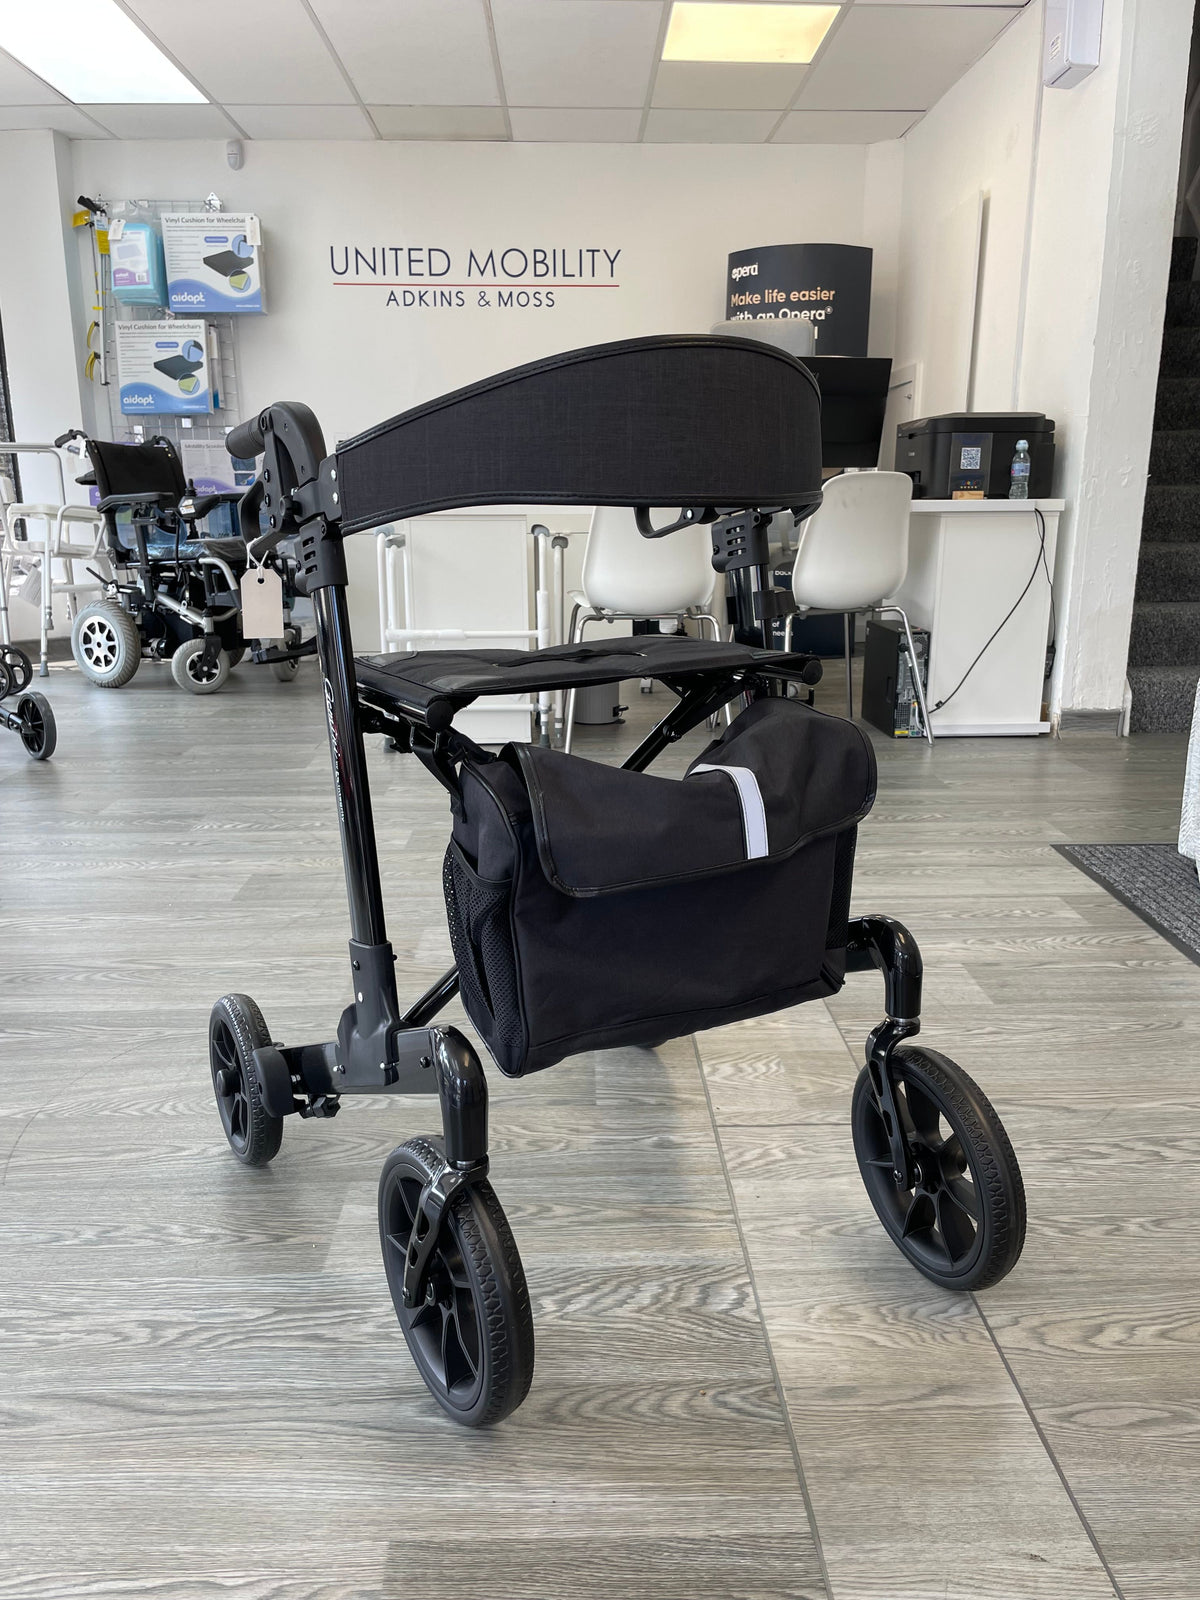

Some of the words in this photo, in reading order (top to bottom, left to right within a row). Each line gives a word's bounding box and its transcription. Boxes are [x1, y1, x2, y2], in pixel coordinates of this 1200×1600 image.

[164, 217, 180, 225] Vinyl
[329, 245, 451, 278] UNITED
[467, 248, 621, 278] MOBILITY
[171, 292, 206, 304] aidapt
[386, 290, 465, 307] ADKINS
[477, 291, 491, 307] &
[498, 291, 555, 307] MOSS
[731, 292, 761, 307] Make
[765, 289, 786, 304] life
[790, 287, 836, 302] easier
[118, 324, 133, 332] Vinyl
[123, 394, 155, 406] aidapt
